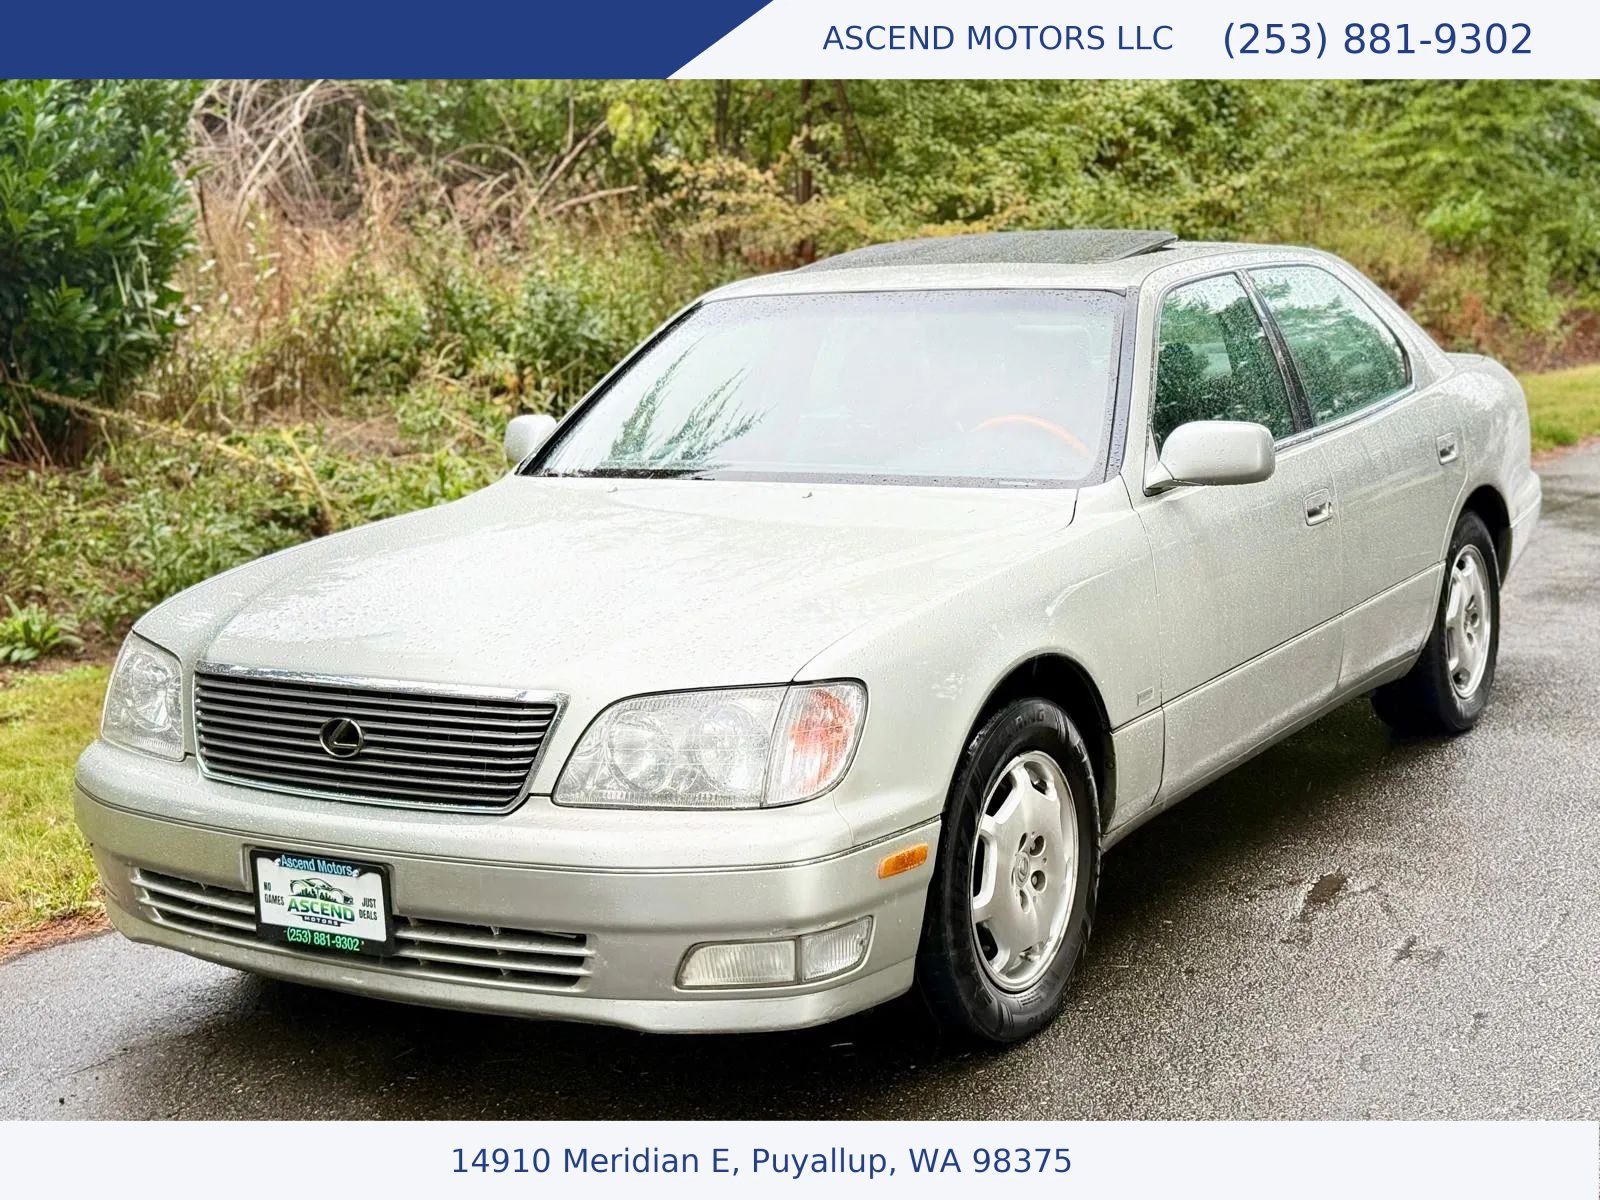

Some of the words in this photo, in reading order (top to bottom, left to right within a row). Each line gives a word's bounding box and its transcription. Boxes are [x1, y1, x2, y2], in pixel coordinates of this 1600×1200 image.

[281, 854, 316, 871] Ascend
[317, 860, 353, 876] Motors
[263, 881, 272, 892] NO
[264, 894, 285, 906] GAMES
[361, 897, 377, 908] JUST
[287, 898, 355, 922] ASCEND
[359, 909, 378, 920] DEALS
[303, 915, 341, 927] MOTORS
[286, 927, 311, 945] (253)
[313, 932, 361, 951] 881-9302
